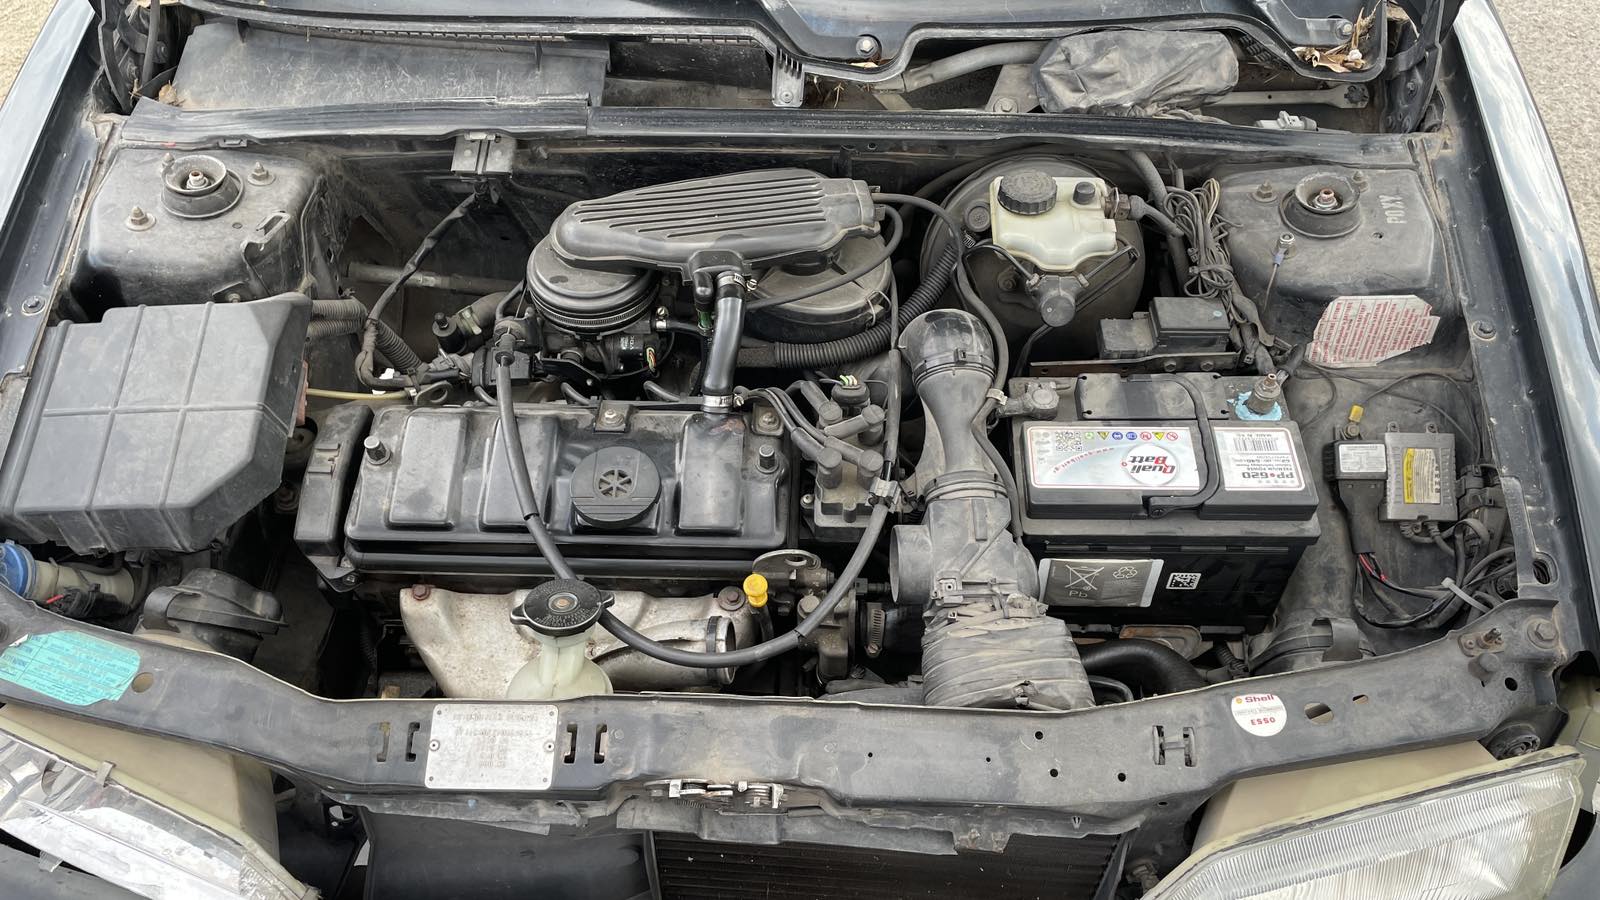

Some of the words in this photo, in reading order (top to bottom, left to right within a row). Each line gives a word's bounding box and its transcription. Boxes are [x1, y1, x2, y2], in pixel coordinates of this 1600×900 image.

[1128, 455, 1168, 465] Batt
[1130, 463, 1176, 474] Quali
[1069, 590, 1088, 598] Pb
[1245, 694, 1274, 703] Shell
